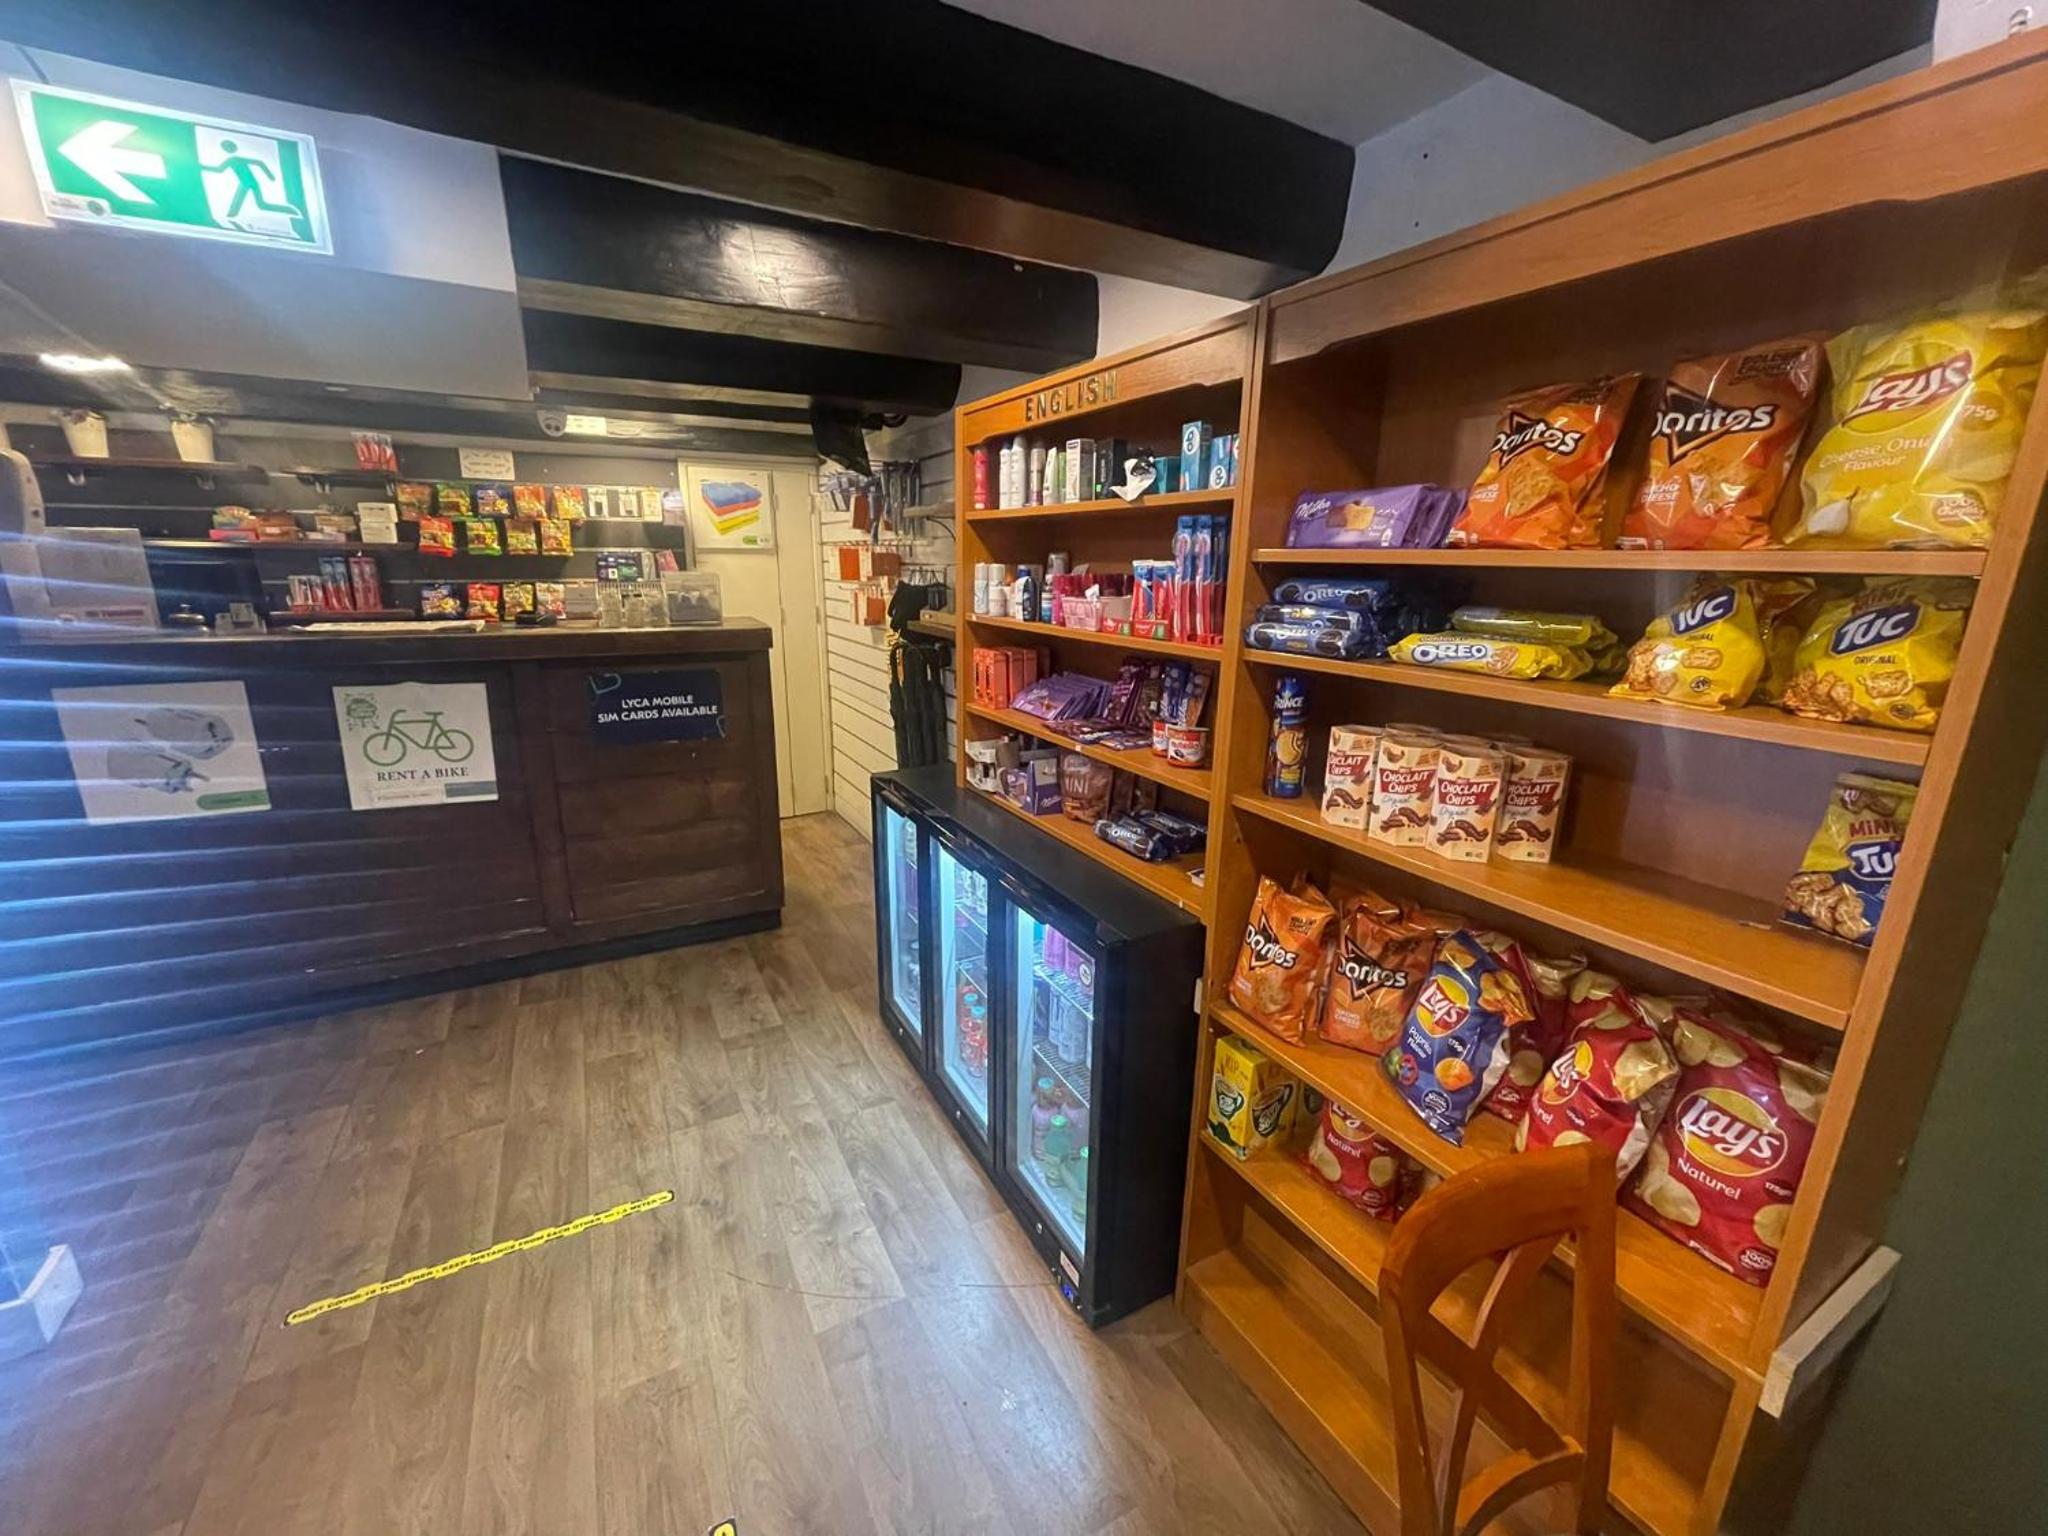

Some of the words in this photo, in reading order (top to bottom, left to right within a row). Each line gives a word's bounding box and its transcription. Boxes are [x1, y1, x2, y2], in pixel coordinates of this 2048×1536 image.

[1025, 369, 1117, 422] ENGLISH
[1887, 436, 1953, 452] Onin
[1295, 498, 1331, 520] Milka
[1677, 595, 1729, 632] TUC
[1838, 611, 1911, 651] TUC
[1412, 643, 1488, 664] OREO
[1853, 655, 1897, 665] ORIINAL
[622, 698, 650, 709] LYCA
[652, 694, 694, 707] MOBILE
[598, 713, 619, 723] SIM
[621, 709, 659, 721] CARDS
[661, 705, 718, 718] AVAILABLE
[377, 769, 418, 782] RENT
[421, 769, 431, 779] A
[435, 766, 469, 778] BIKE
[1382, 771, 1429, 782] CHOCLAIT
[1388, 782, 1418, 793] CHIPS
[1441, 781, 1490, 794] CHOCLAIT
[1508, 783, 1552, 794] HOCLAIT
[1446, 794, 1476, 805] CHIPS
[1851, 845, 1901, 874] TU
[1677, 1157, 1741, 1200] Naturel
